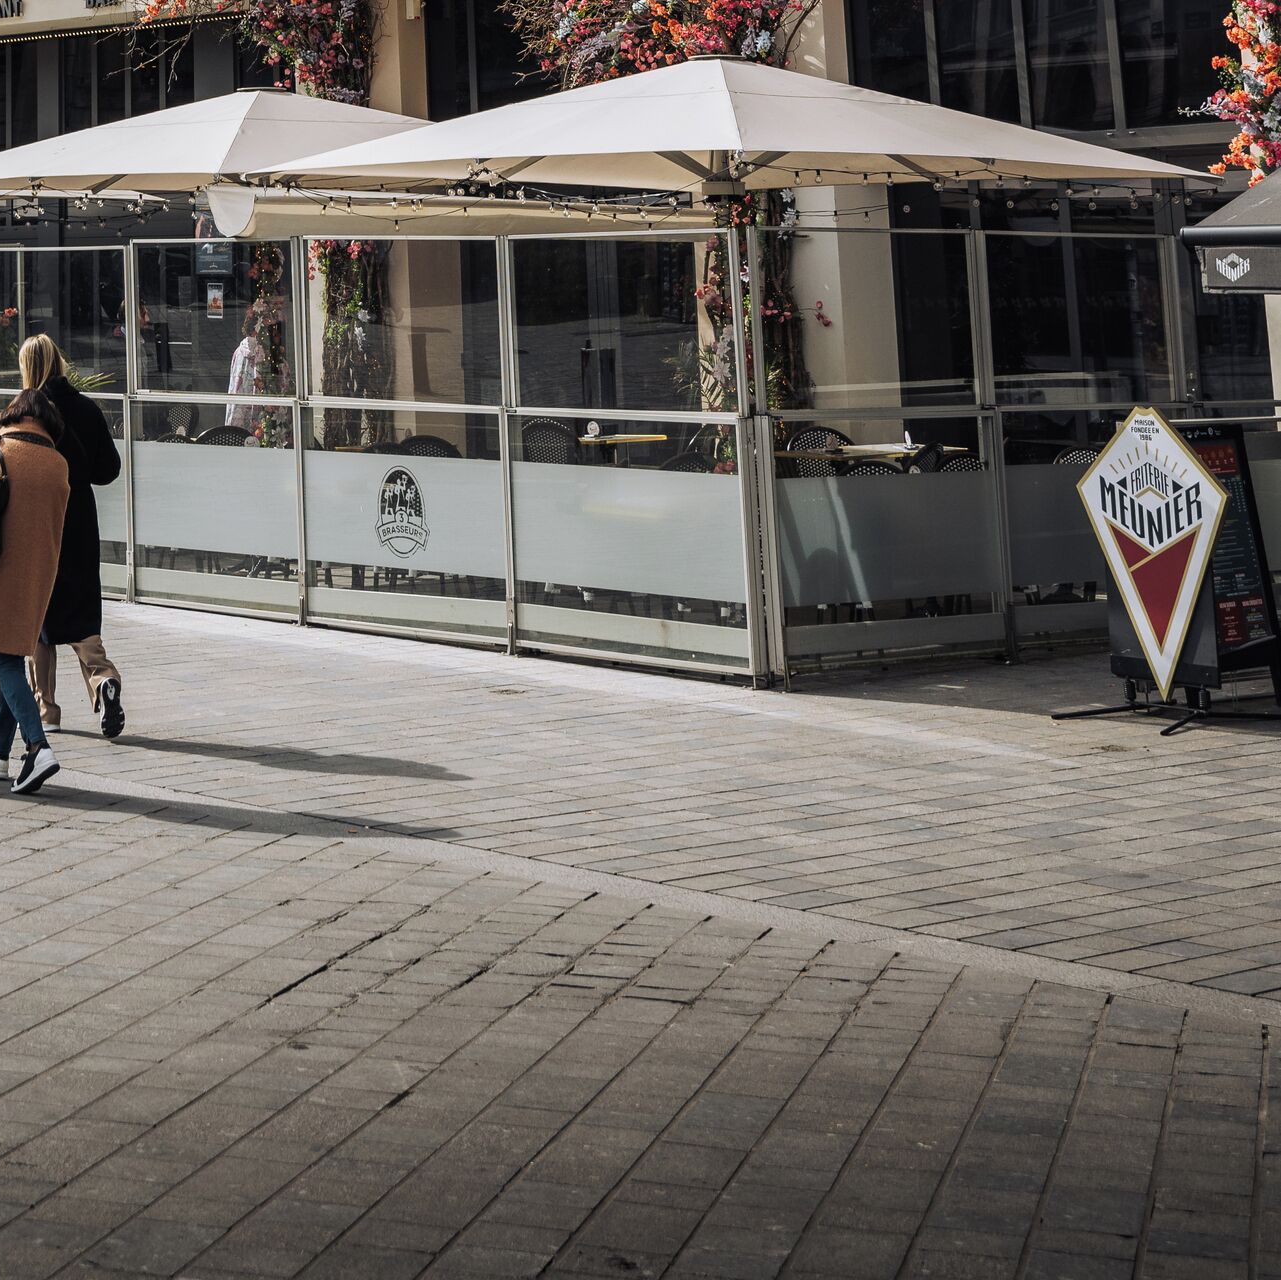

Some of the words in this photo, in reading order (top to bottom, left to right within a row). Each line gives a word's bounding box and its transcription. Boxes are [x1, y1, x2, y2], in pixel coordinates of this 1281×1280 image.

[1215, 257, 1250, 282] MEUNIER
[1139, 433, 1153, 441] 1986
[1130, 462, 1170, 498] FRITERIE
[399, 513, 404, 523] 3
[1099, 474, 1202, 548] MEUNIER
[381, 525, 423, 539] BRASSEURS
